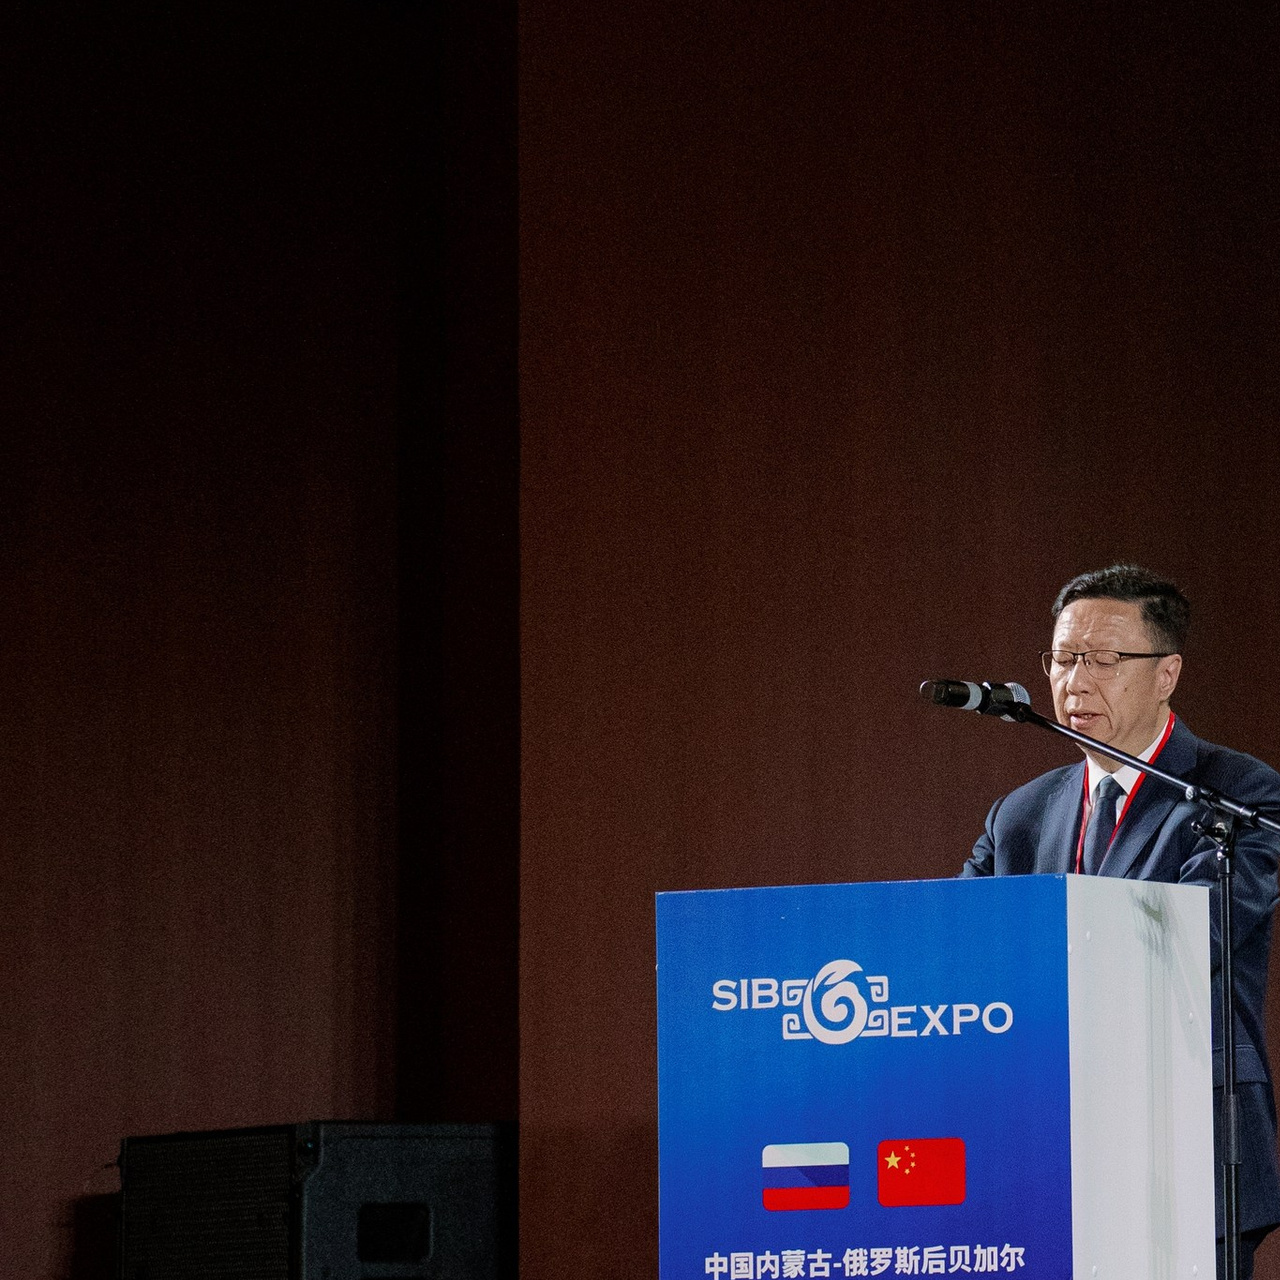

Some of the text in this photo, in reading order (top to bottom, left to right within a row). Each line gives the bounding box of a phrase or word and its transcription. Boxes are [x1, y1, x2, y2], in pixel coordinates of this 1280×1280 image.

[712, 977, 1014, 1038] SIB EXPO
[704, 1243, 1026, 1280] 中国内蒙古-俄罗斯后贝加尔
